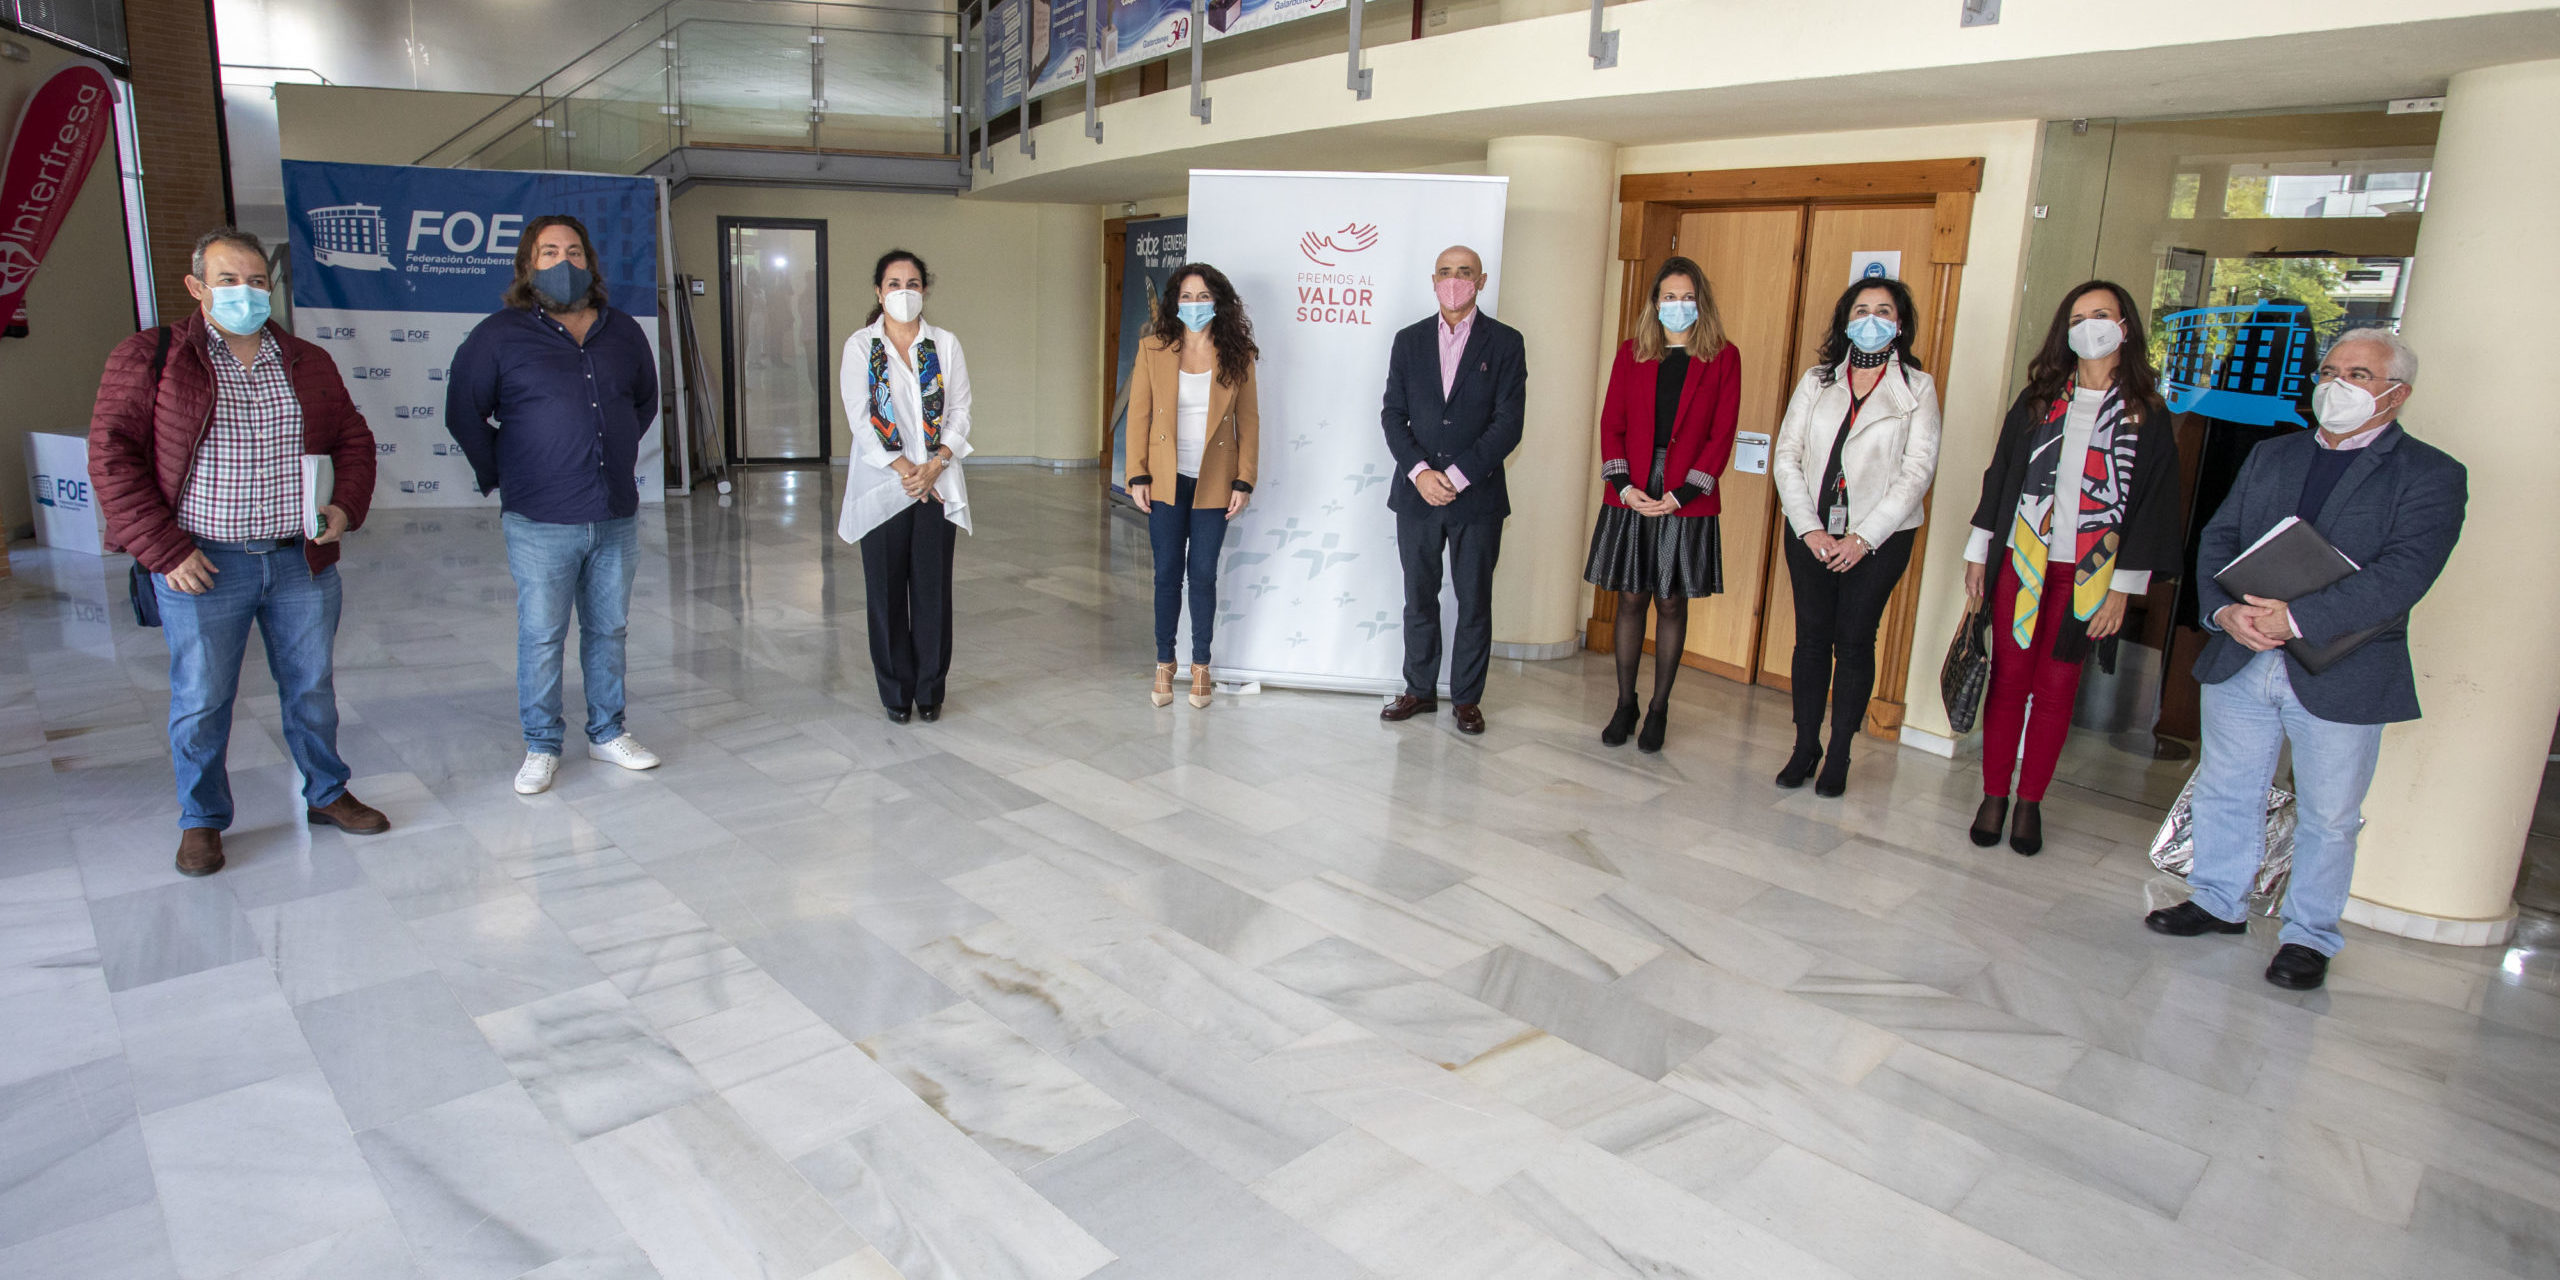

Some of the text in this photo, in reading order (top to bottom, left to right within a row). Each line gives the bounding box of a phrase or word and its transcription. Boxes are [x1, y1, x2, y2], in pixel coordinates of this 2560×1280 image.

[1, 84, 98, 242] Interfresa
[407, 210, 523, 254] FOE
[406, 253, 462, 265] Federación
[406, 264, 487, 275] de Empresarios
[1298, 272, 1375, 286] PREMIOS AL
[1298, 286, 1373, 307] VALOR
[1296, 306, 1371, 325] SOCIAL
[334, 327, 357, 337] FOE
[408, 330, 430, 339] FOE
[369, 368, 392, 377] FOE
[412, 406, 435, 415] FOE
[375, 443, 397, 452] FOE
[450, 443, 463, 452] FO
[57, 479, 88, 502] FOE
[417, 481, 440, 490] FOE
